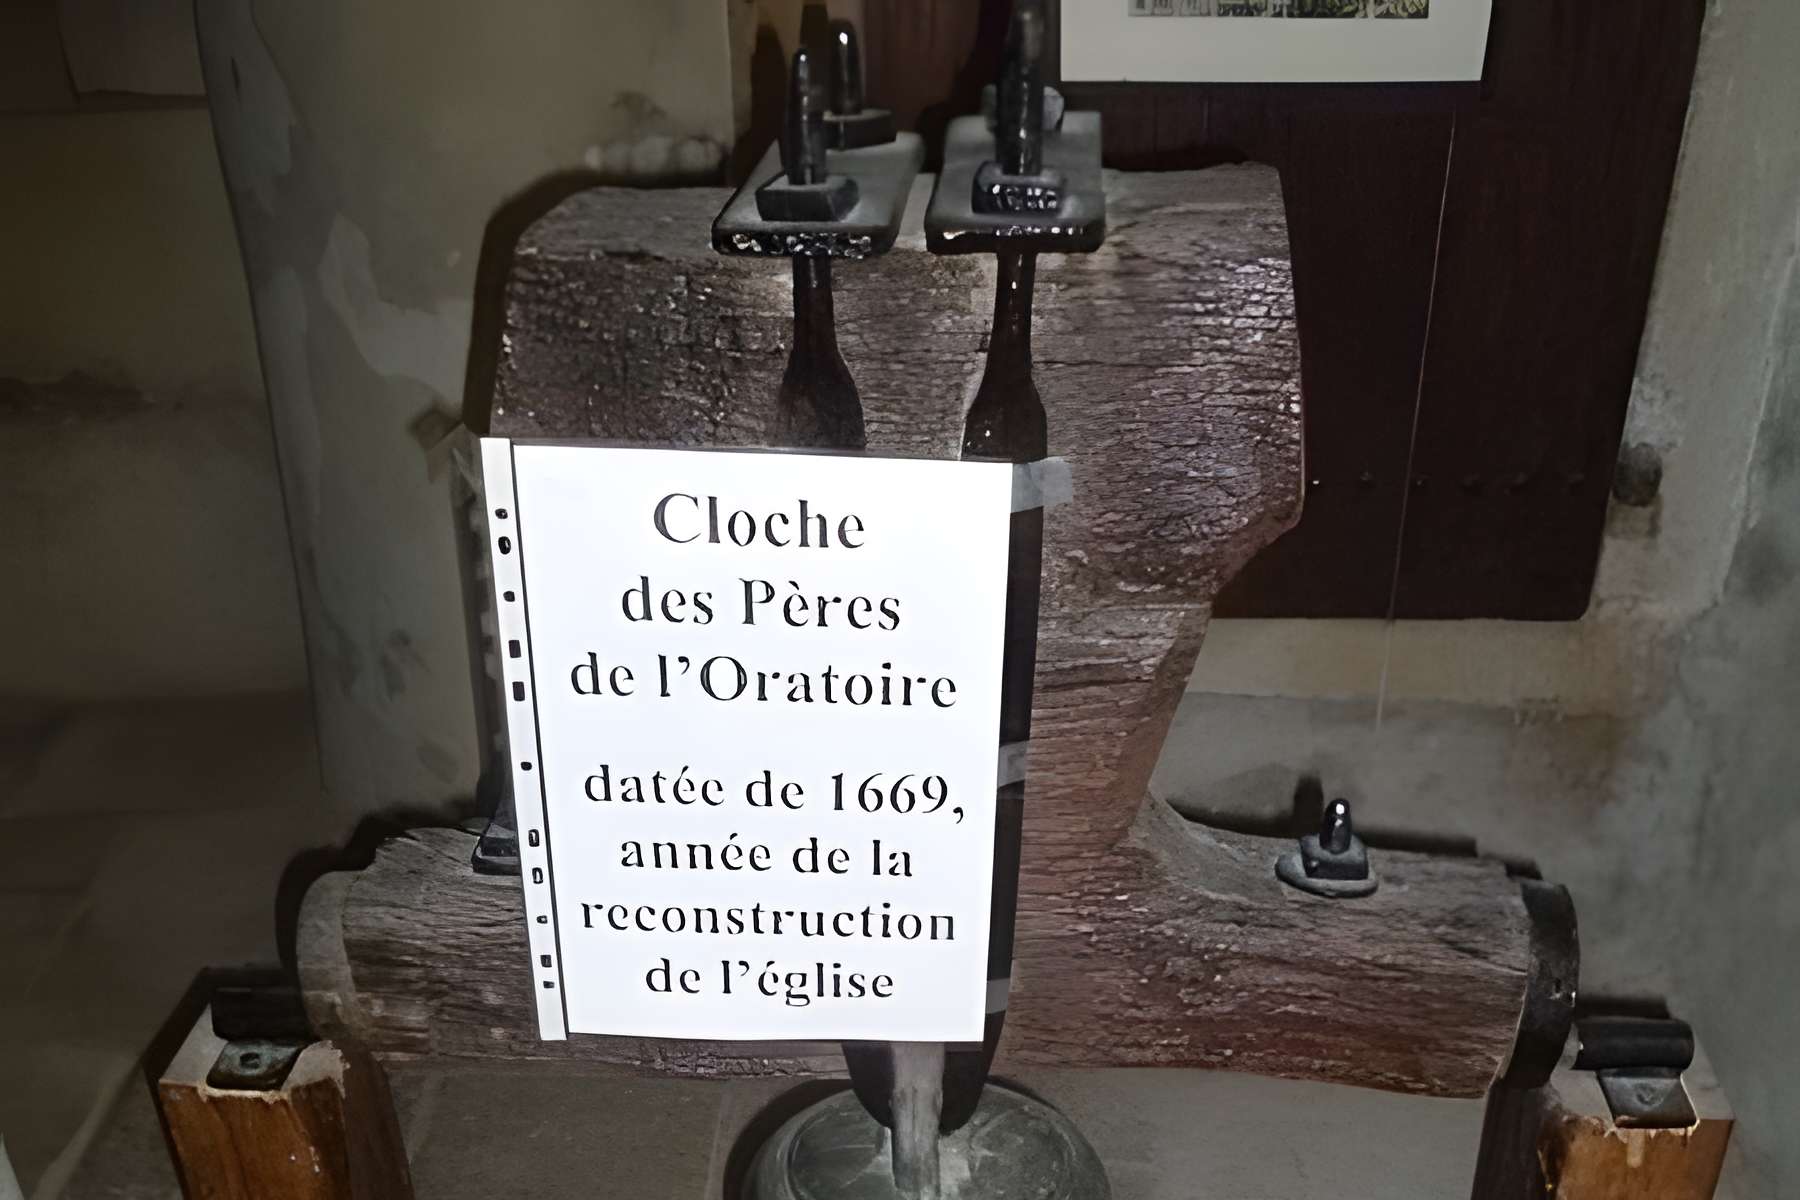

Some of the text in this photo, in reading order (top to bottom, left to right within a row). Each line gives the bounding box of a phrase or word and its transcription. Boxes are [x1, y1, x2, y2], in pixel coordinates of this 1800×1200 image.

[653, 492, 866, 549] Cloche
[621, 575, 902, 632] des Pères
[570, 651, 957, 708] de l’Oratoire
[584, 764, 965, 825] datée de 1669,
[620, 832, 914, 878] année de la
[582, 901, 955, 941] reconstruction
[645, 957, 894, 1008] de l’église
